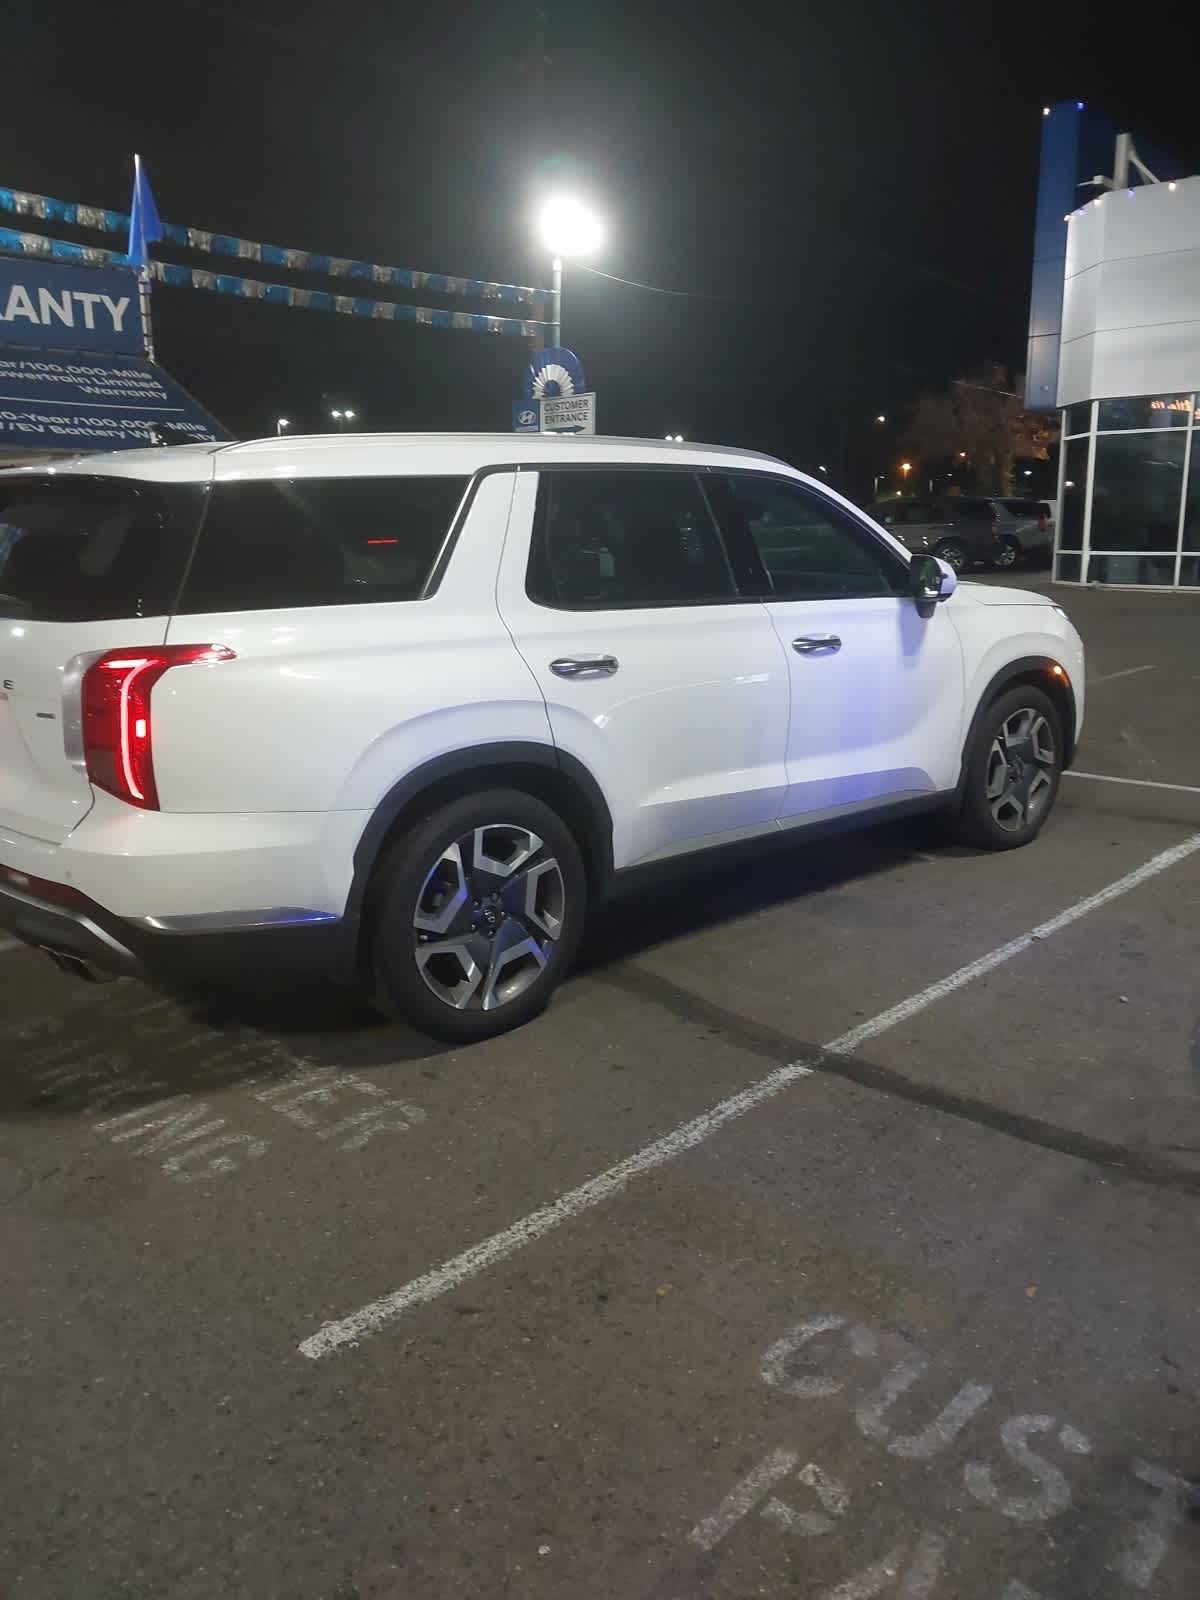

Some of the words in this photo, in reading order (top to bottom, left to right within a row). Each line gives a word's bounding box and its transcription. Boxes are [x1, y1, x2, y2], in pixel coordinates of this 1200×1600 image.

[0, 285, 130, 332] ANTY
[91, 377, 163, 389] Limited
[78, 385, 168, 401] Warranty
[544, 400, 589, 412] CUSTOMER
[544, 412, 589, 425] ENTRANCE
[48, 425, 125, 439] Battery
